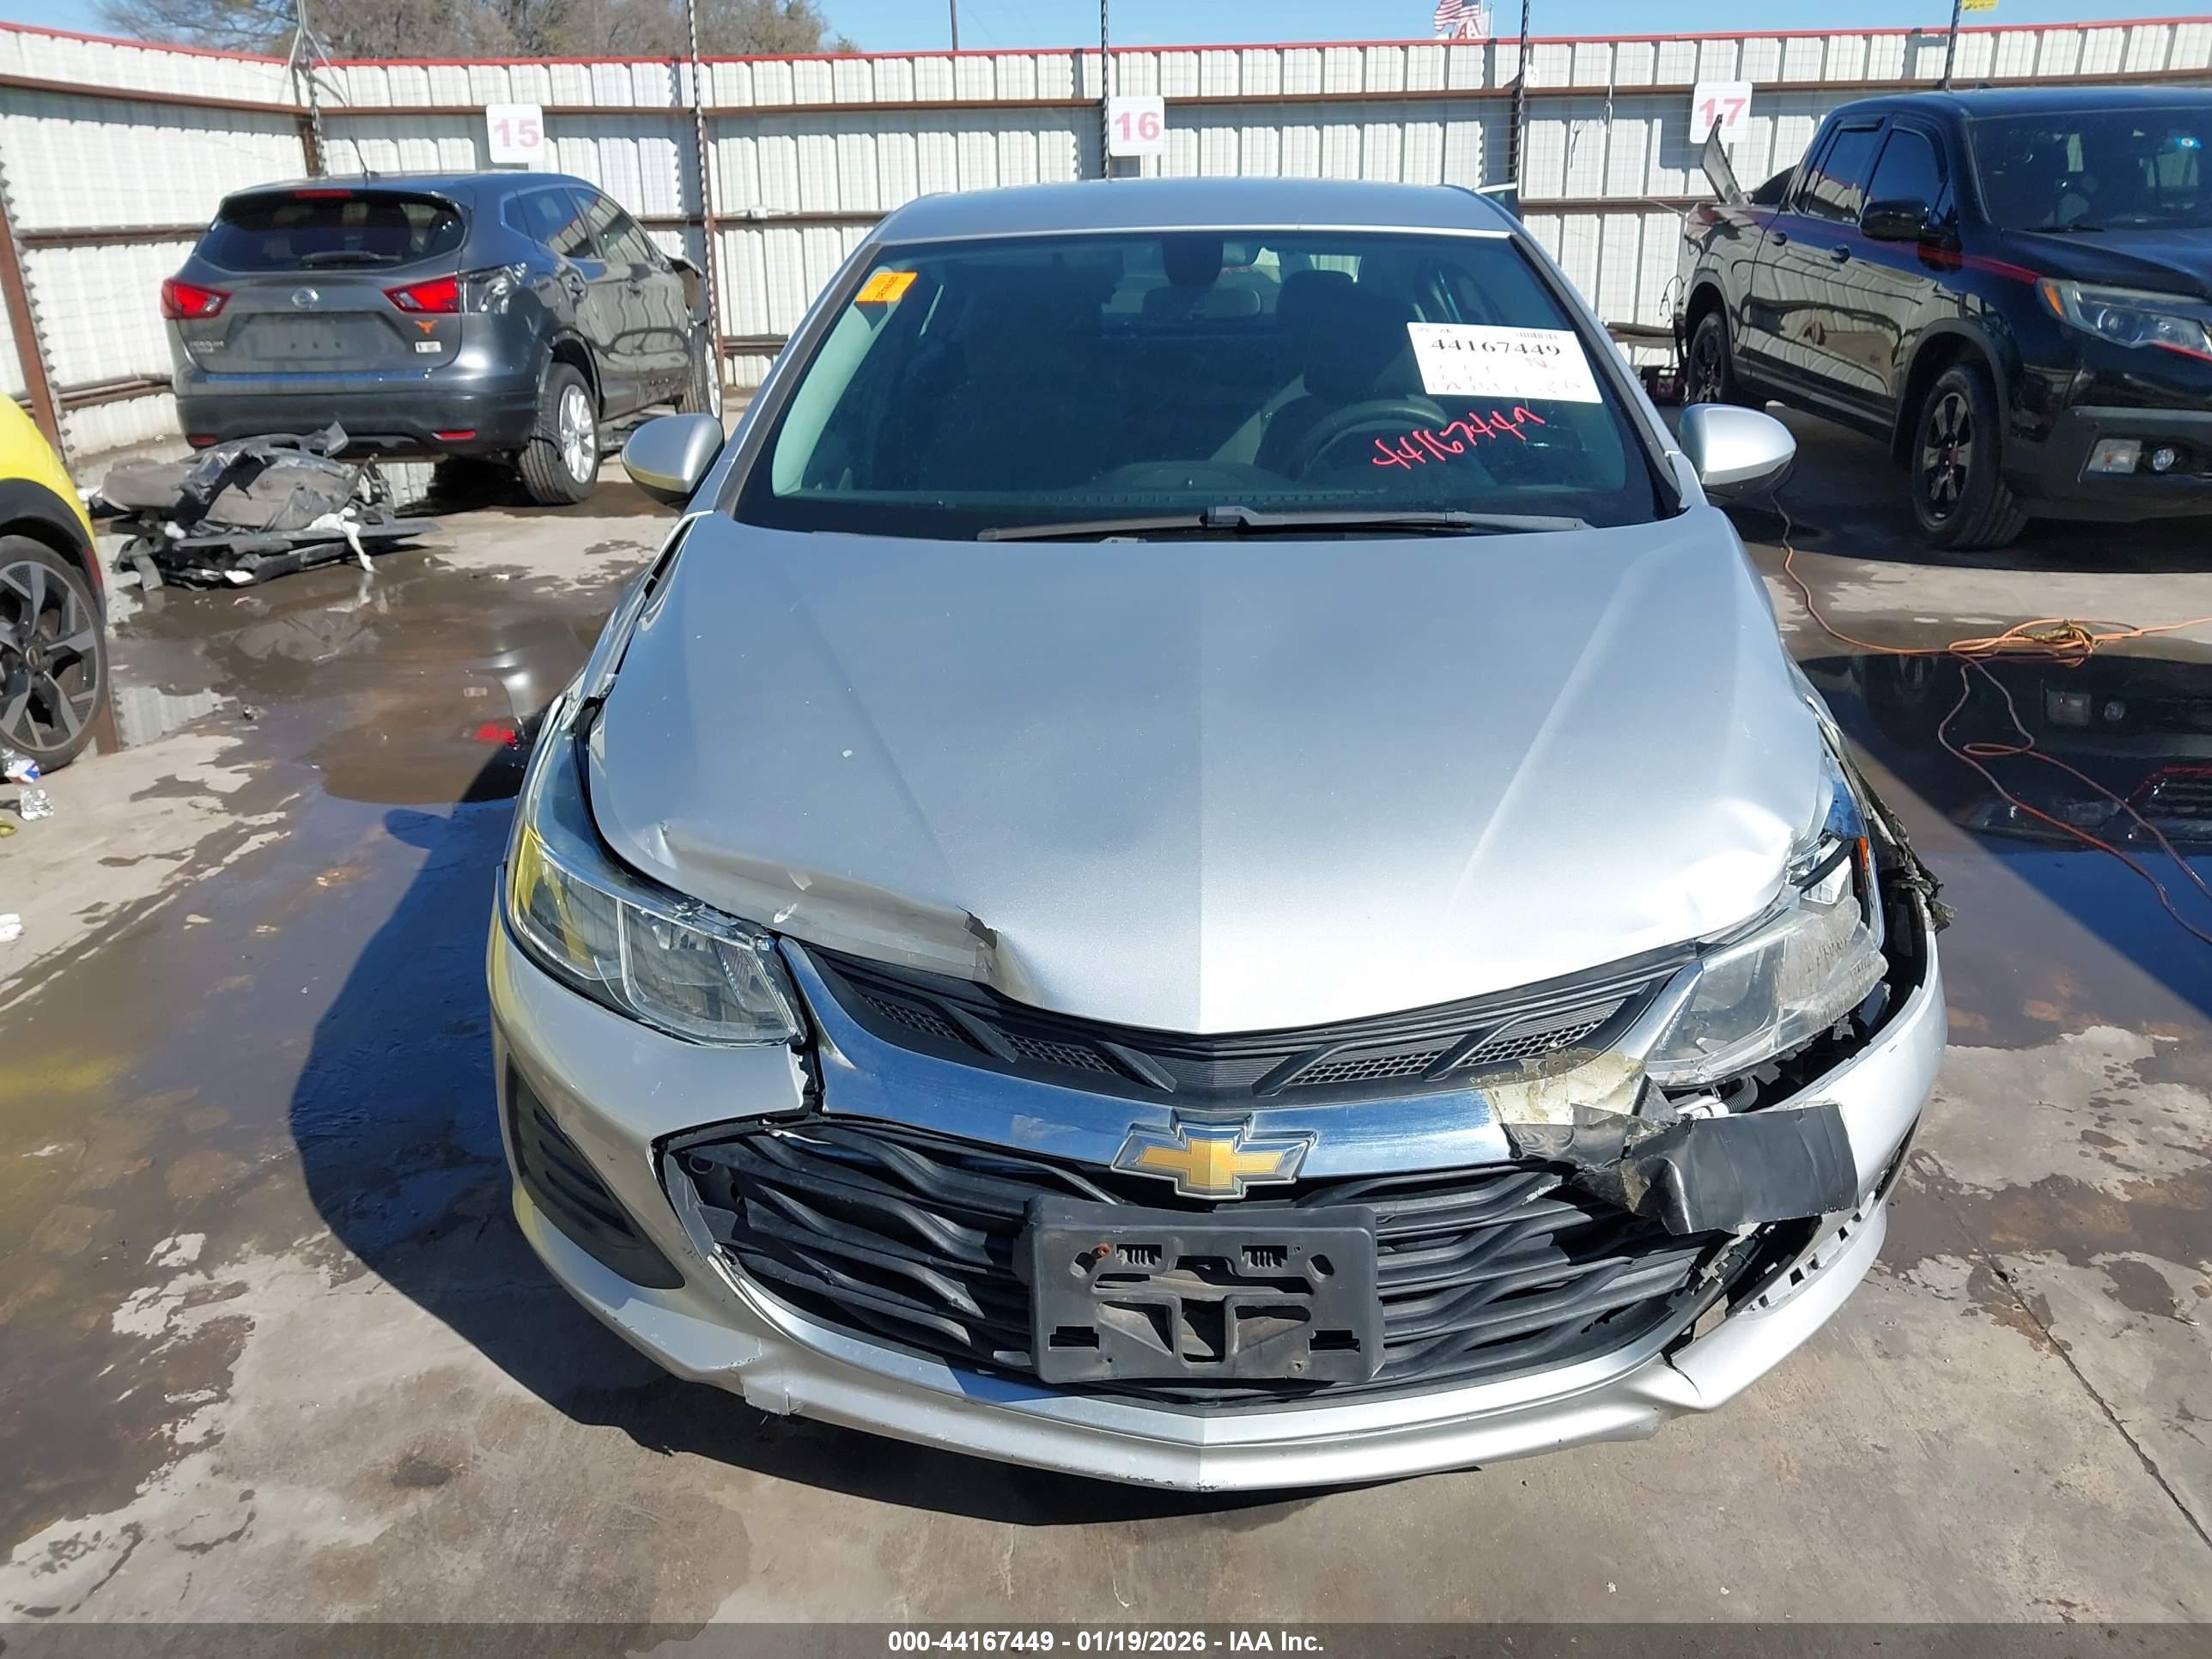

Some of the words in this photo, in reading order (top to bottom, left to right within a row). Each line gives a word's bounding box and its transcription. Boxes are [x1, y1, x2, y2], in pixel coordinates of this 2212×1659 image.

[1115, 111, 1160, 141] 16
[1698, 98, 1747, 127] 17
[495, 118, 539, 148] 15
[1431, 338, 1561, 356] 44167449
[1373, 406, 1546, 470] 44167449
